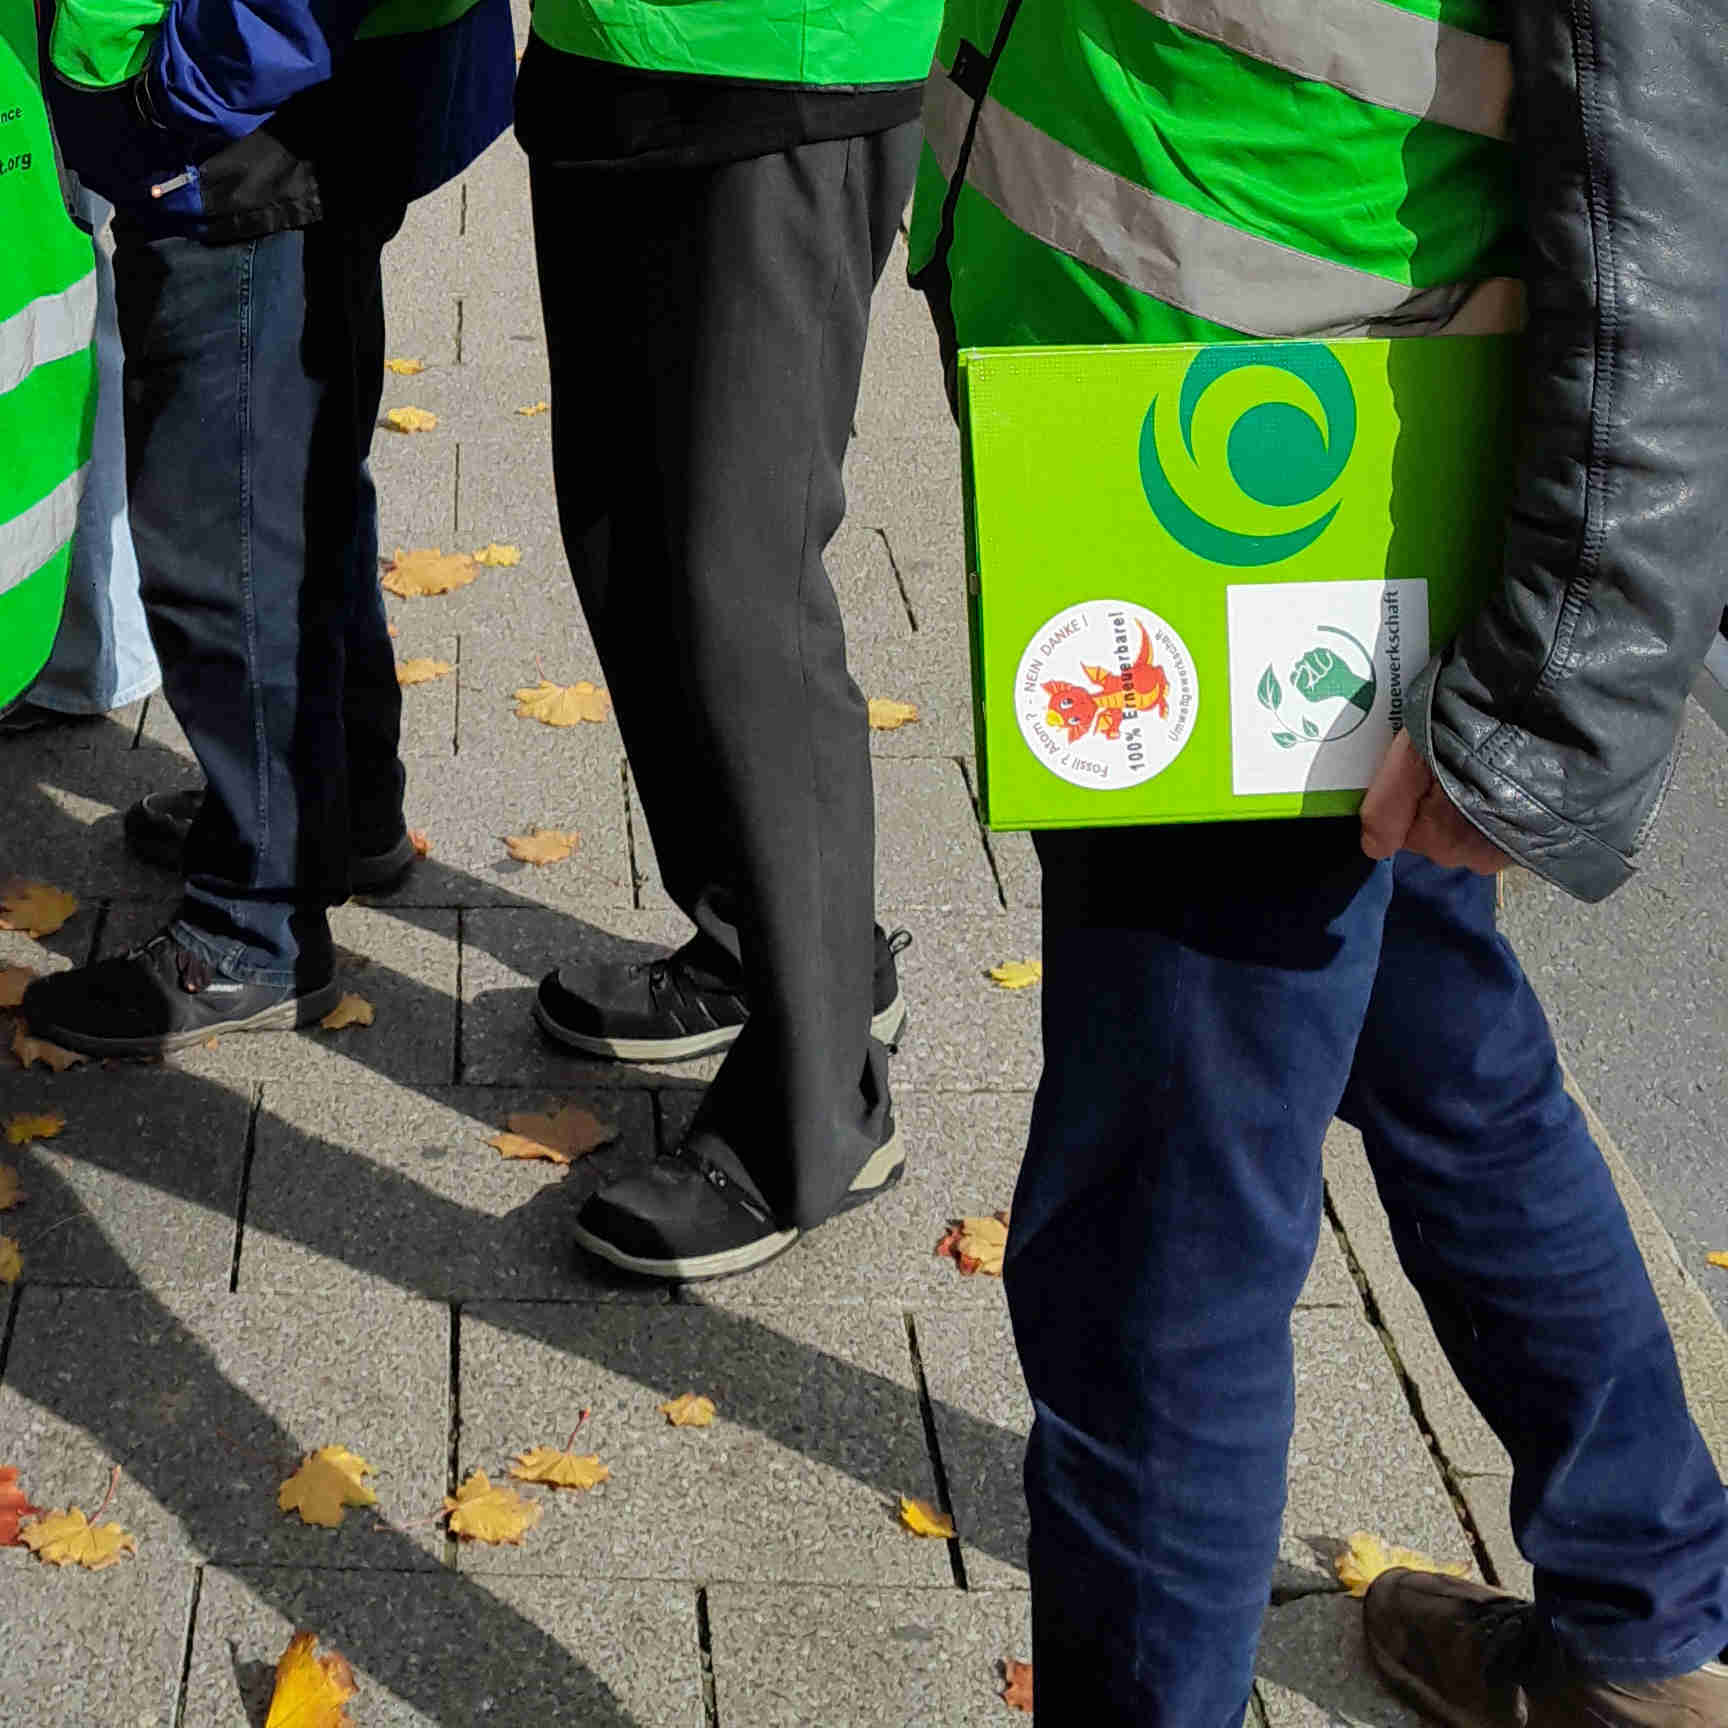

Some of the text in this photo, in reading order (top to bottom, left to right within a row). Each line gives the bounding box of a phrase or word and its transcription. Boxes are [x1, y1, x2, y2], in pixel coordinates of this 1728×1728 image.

[1040, 618, 1081, 657] DANKE
[1023, 658, 1044, 693] NEIN
[1033, 721, 1061, 755] Atom
[1126, 728, 1146, 772] 100%
[1071, 759, 1110, 778] Fossil
